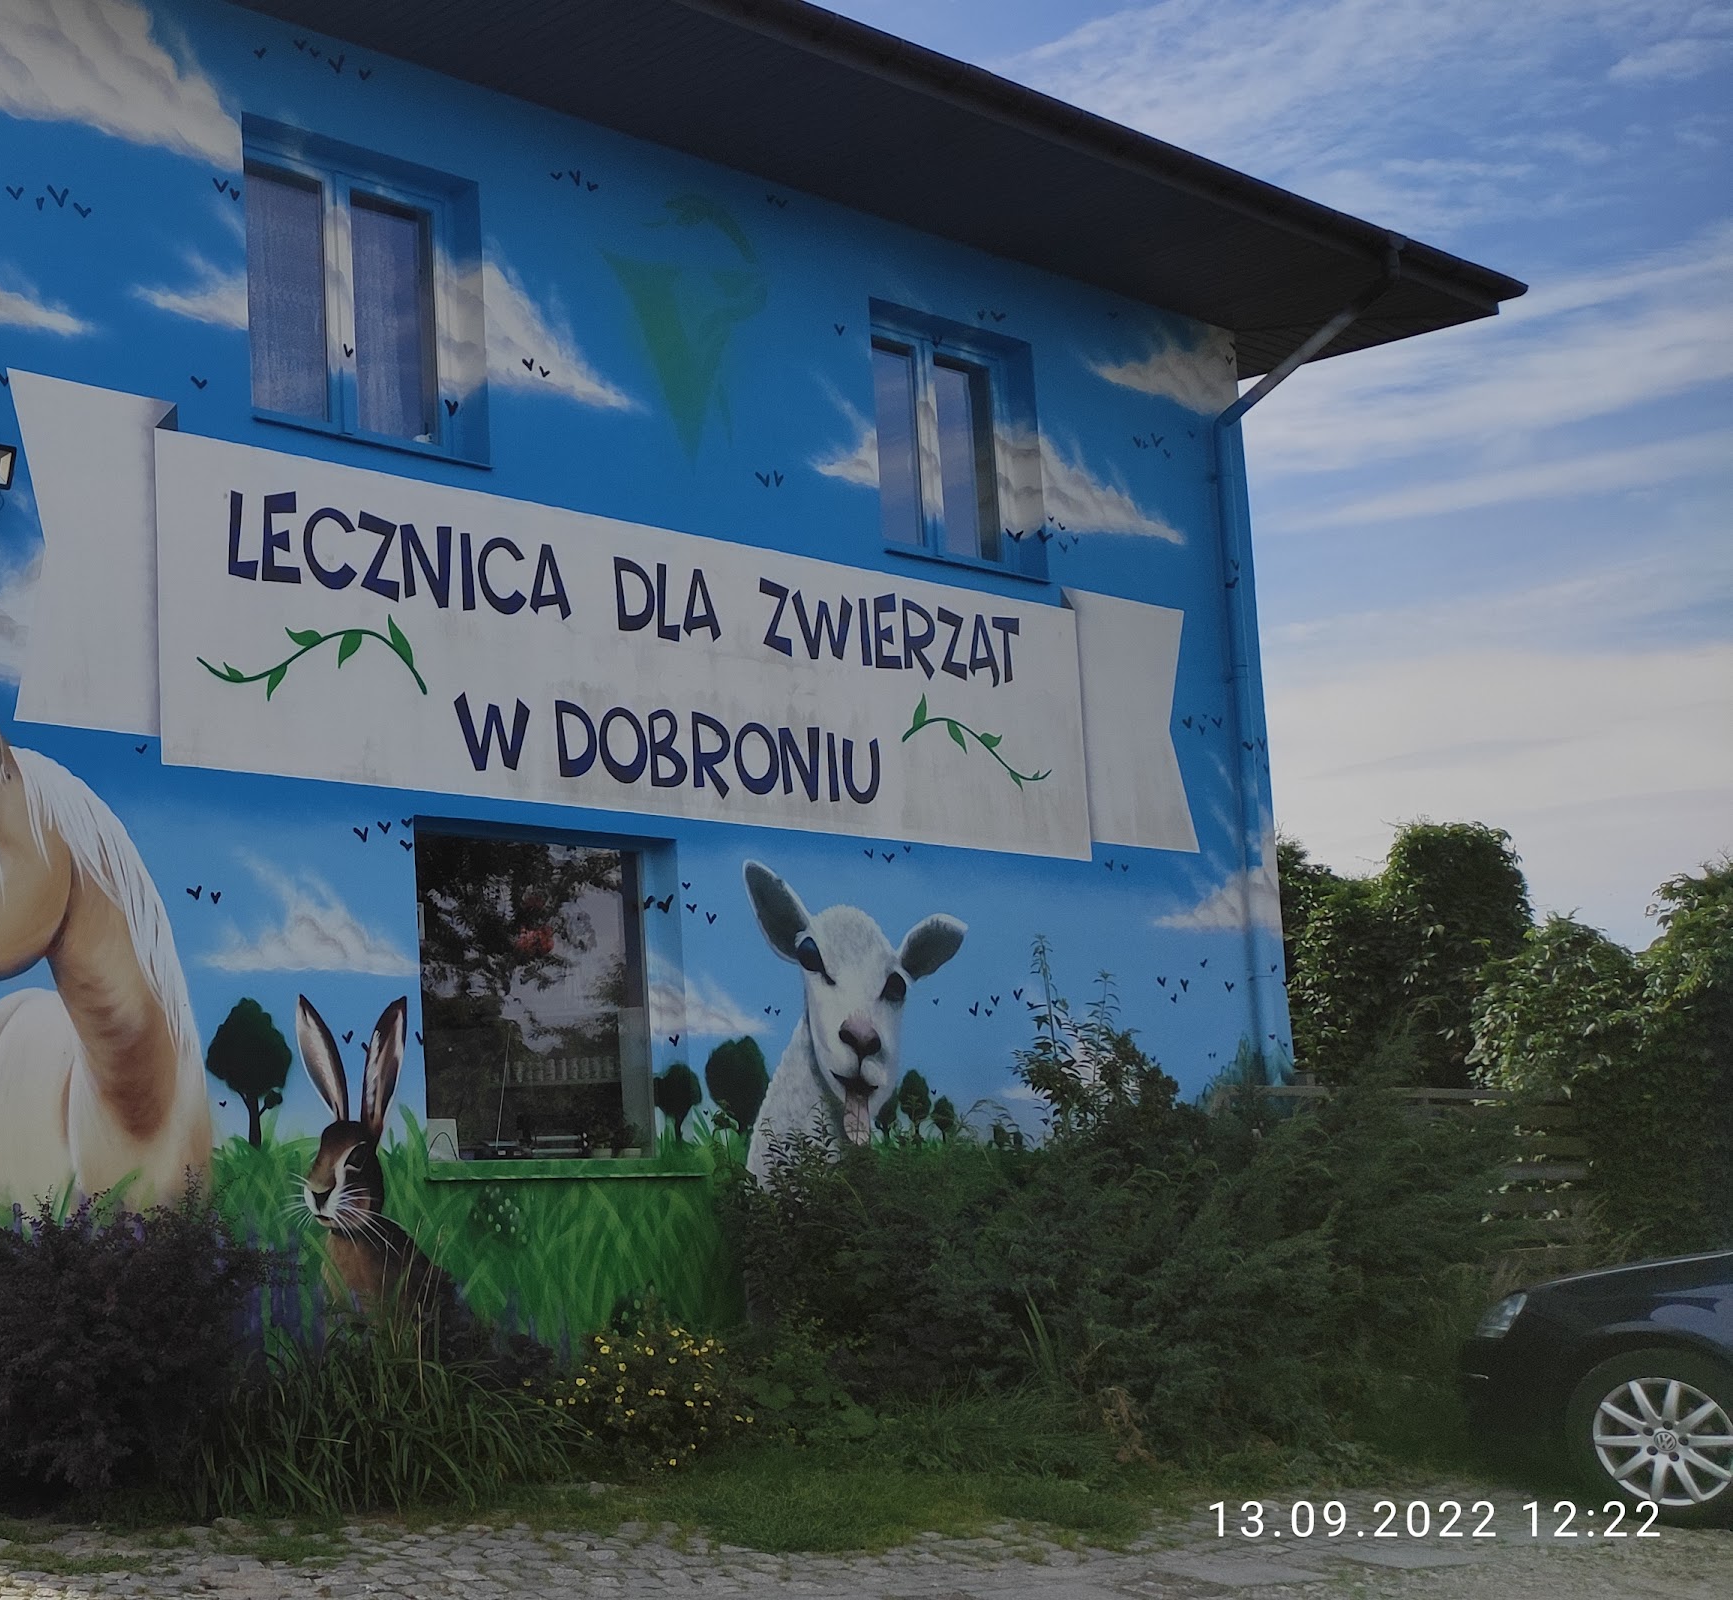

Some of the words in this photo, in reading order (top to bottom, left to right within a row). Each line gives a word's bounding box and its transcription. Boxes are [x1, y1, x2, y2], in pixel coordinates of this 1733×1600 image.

[227, 488, 572, 619] LECZNICA
[613, 555, 722, 643] DLA
[759, 576, 1021, 689] ZWIERZĄT
[453, 691, 530, 773] W
[554, 698, 882, 806] DOBRONIU
